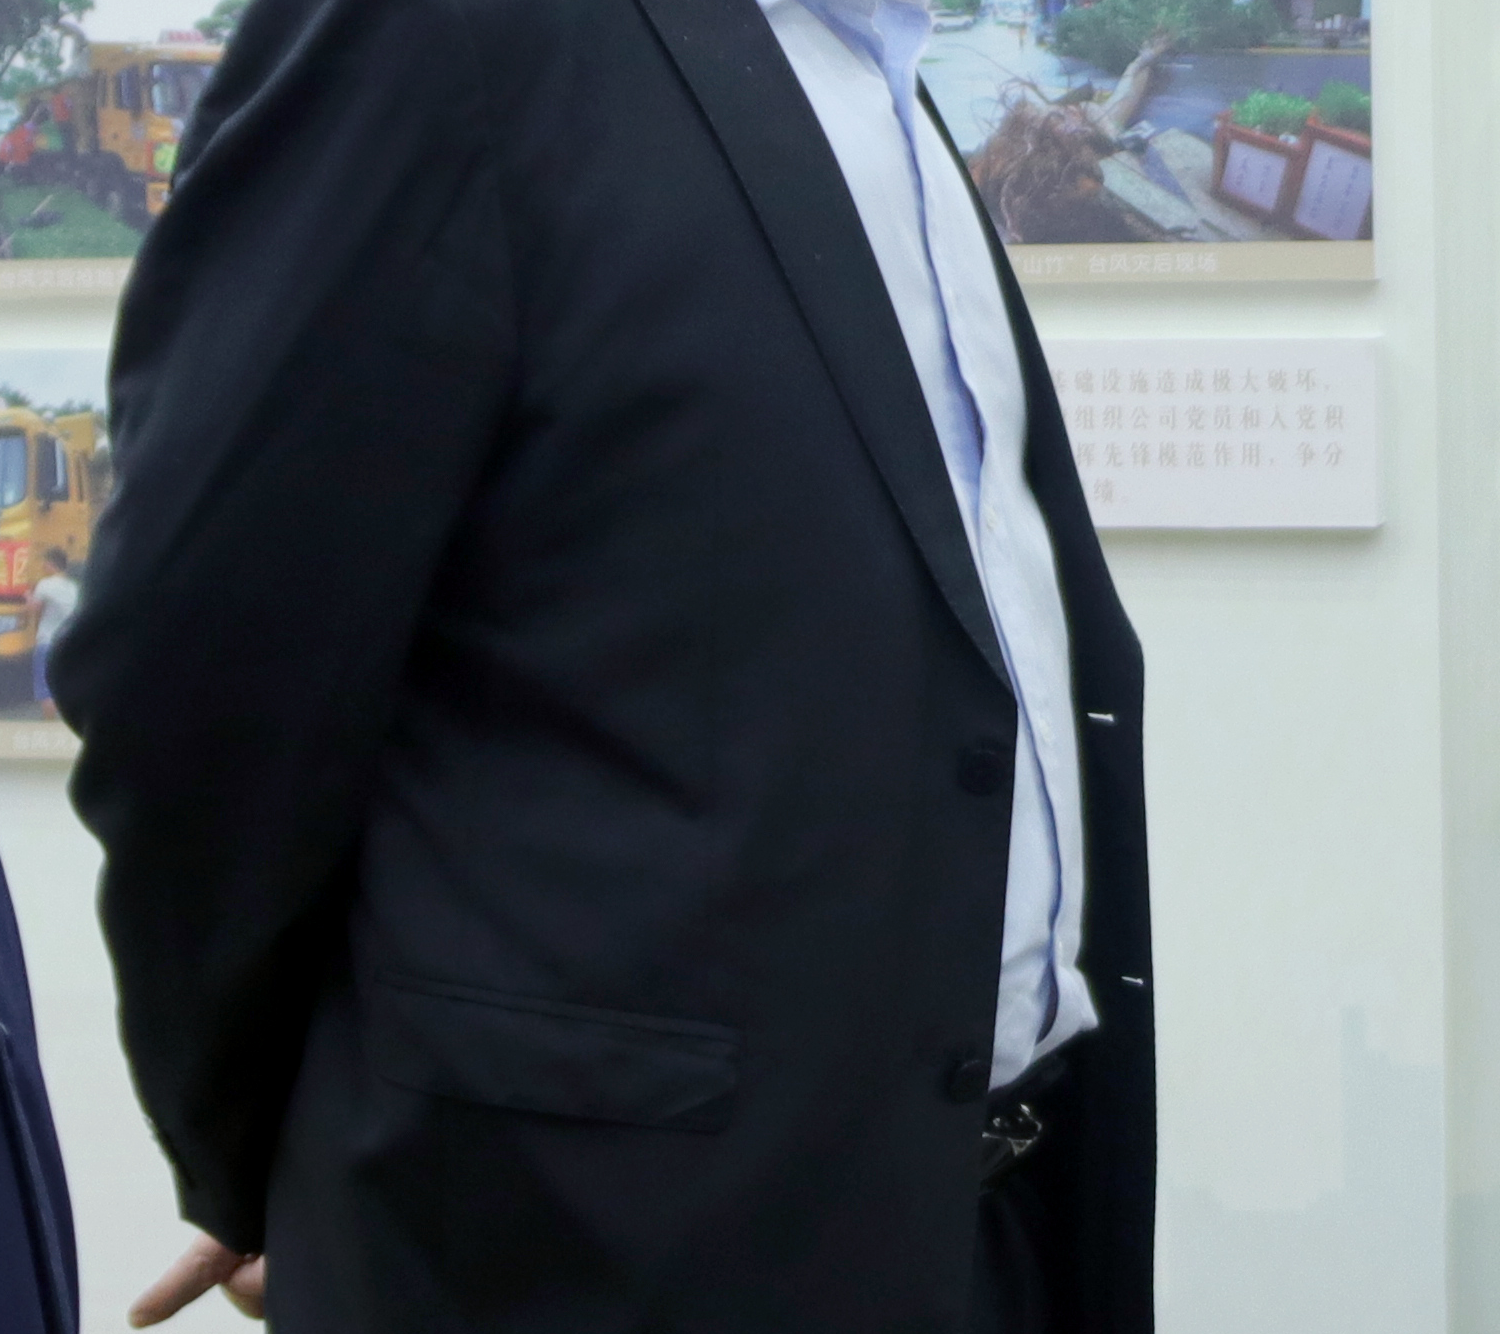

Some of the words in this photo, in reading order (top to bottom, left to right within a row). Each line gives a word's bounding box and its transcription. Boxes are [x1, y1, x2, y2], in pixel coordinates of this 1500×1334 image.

[1066, 404, 1346, 431] 组织公司党员和入党积
